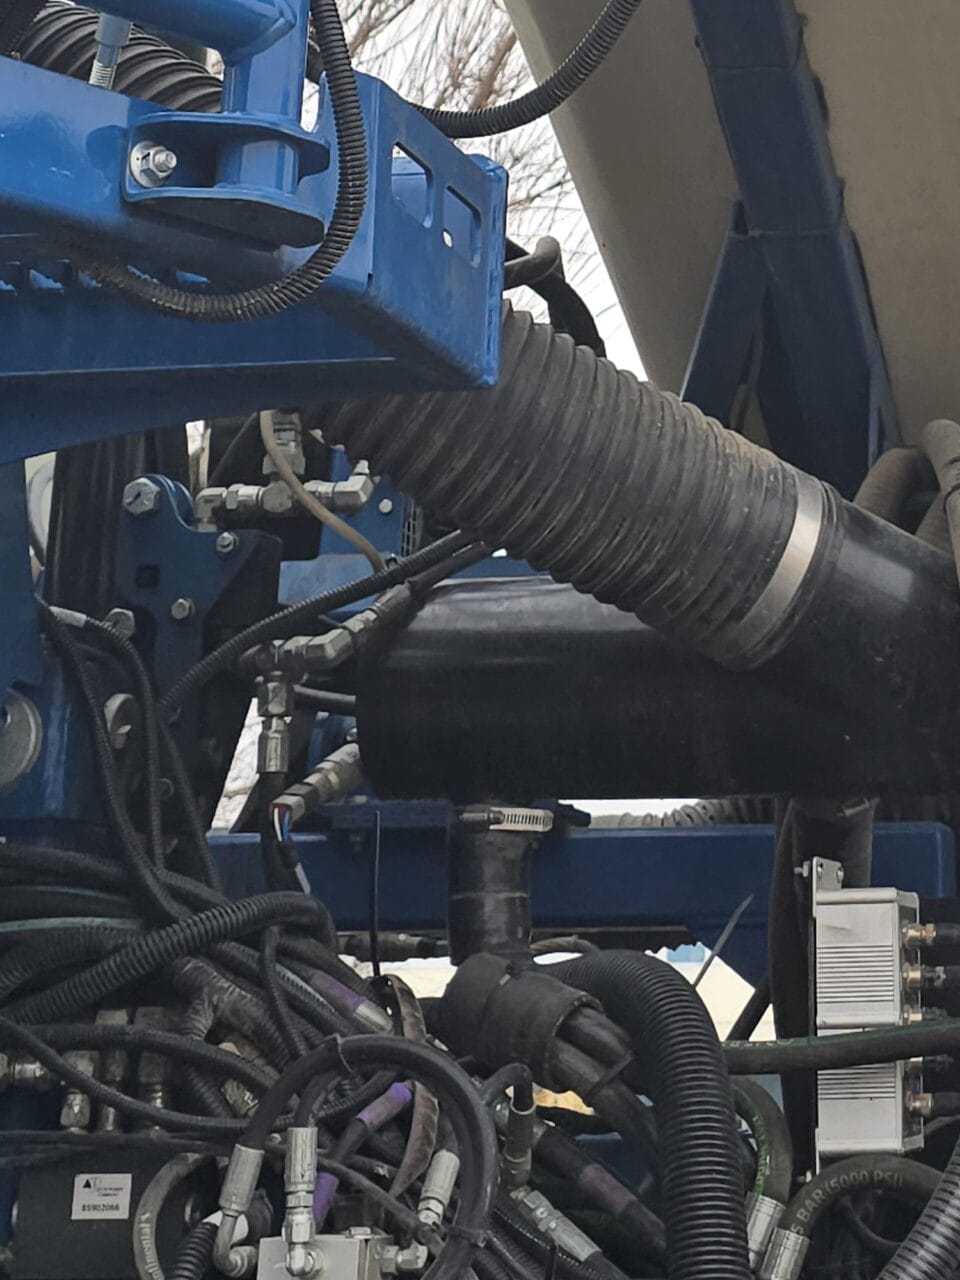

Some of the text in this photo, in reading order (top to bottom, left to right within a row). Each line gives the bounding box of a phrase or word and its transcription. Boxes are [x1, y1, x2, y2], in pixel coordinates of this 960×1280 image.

[795, 1188, 827, 1223] BAR
[825, 1170, 869, 1195] (5000
[874, 1169, 903, 1187] PSI)
